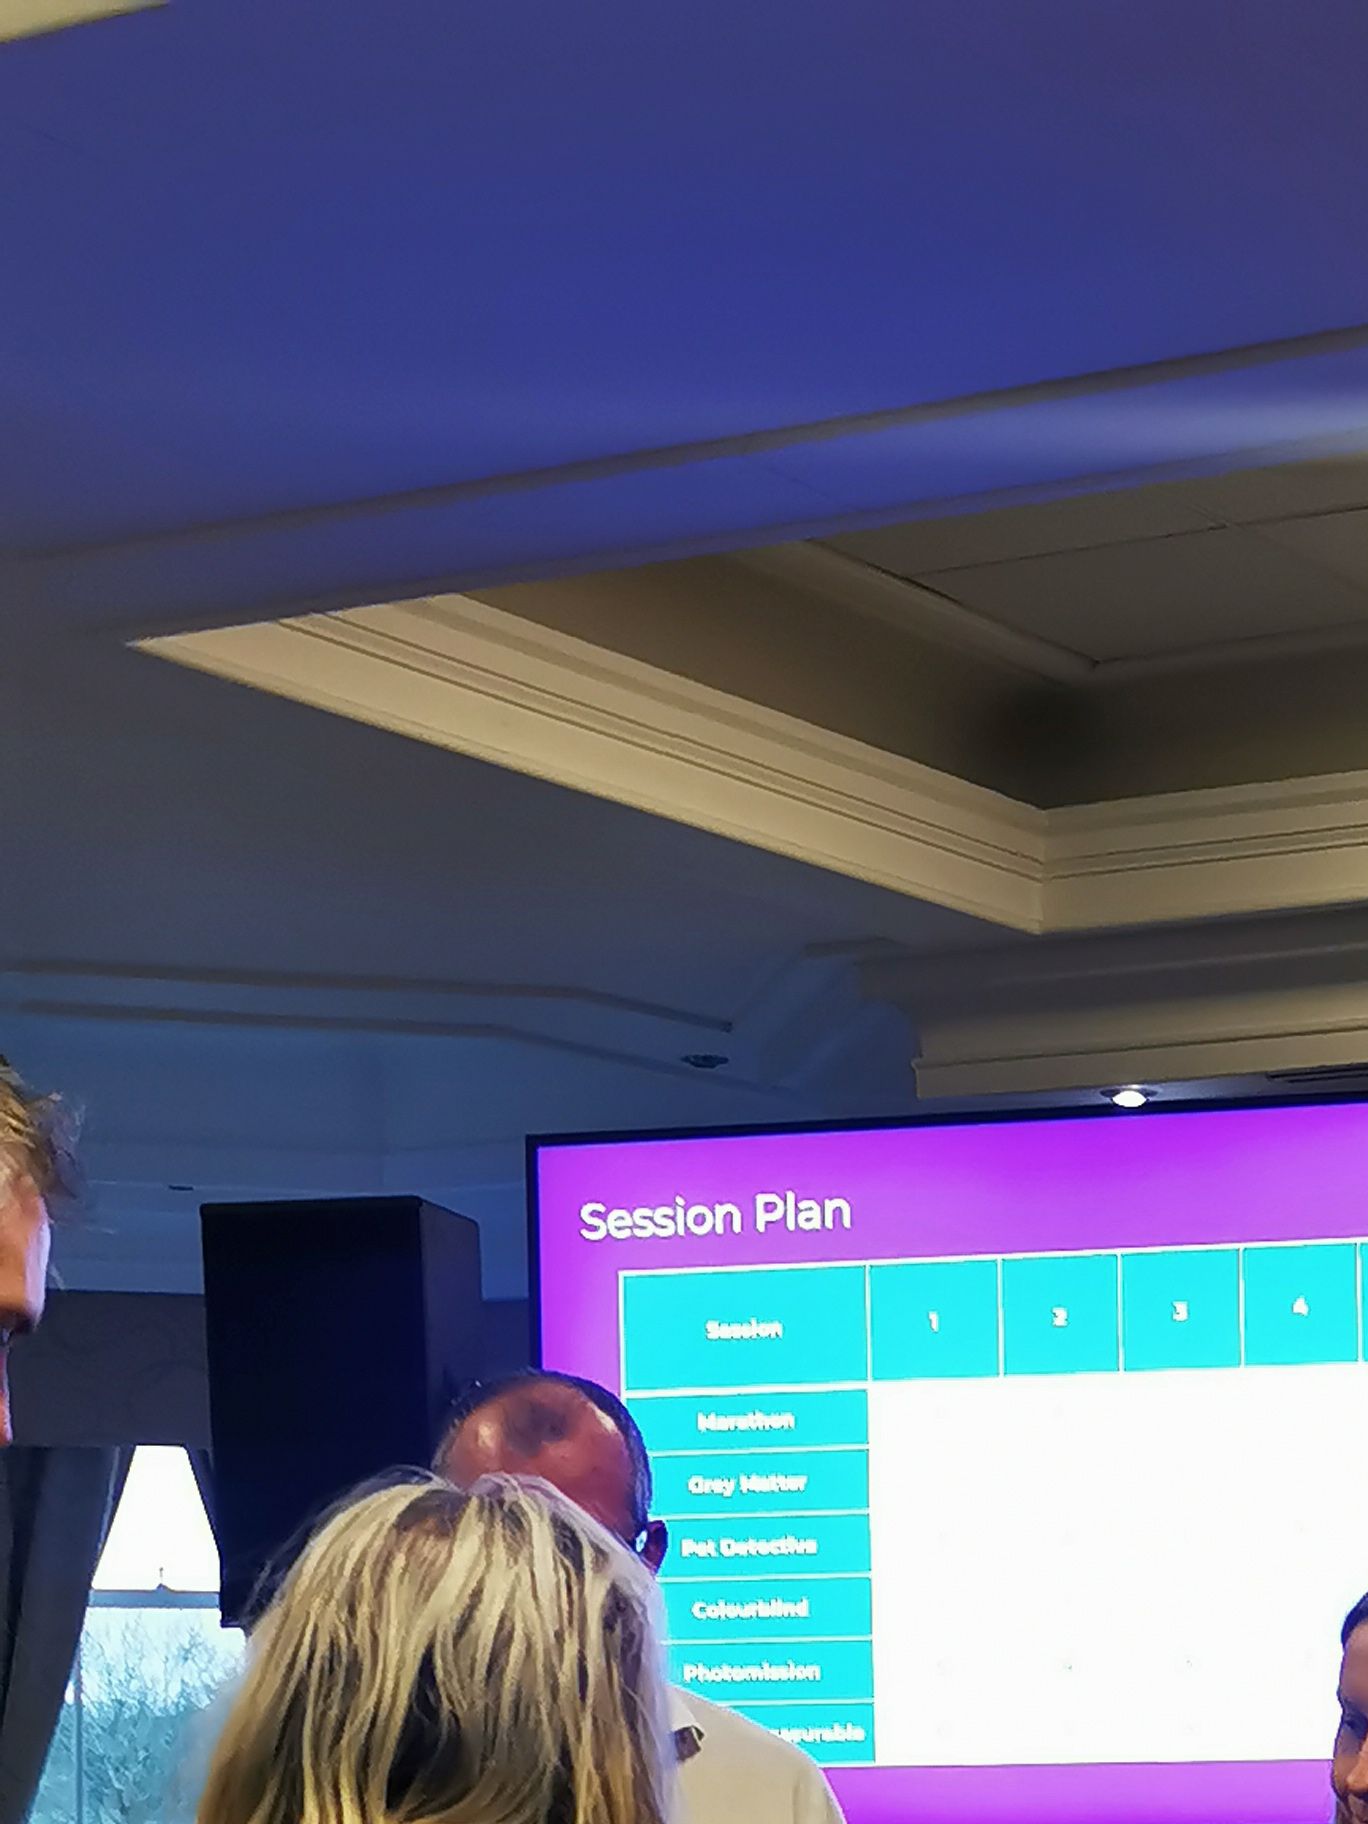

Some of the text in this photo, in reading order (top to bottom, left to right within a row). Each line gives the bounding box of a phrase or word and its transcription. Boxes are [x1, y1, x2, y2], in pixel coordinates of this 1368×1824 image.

[579, 1189, 851, 1241] Session Plan
[705, 1317, 784, 1340] Session
[928, 1312, 939, 1332] 1
[1052, 1307, 1068, 1327] 2
[1173, 1301, 1189, 1321] 3
[1292, 1297, 1309, 1316] 4
[697, 1411, 795, 1432] Marathon
[687, 1475, 735, 1497] Grey
[681, 1535, 817, 1557] Pet Detective
